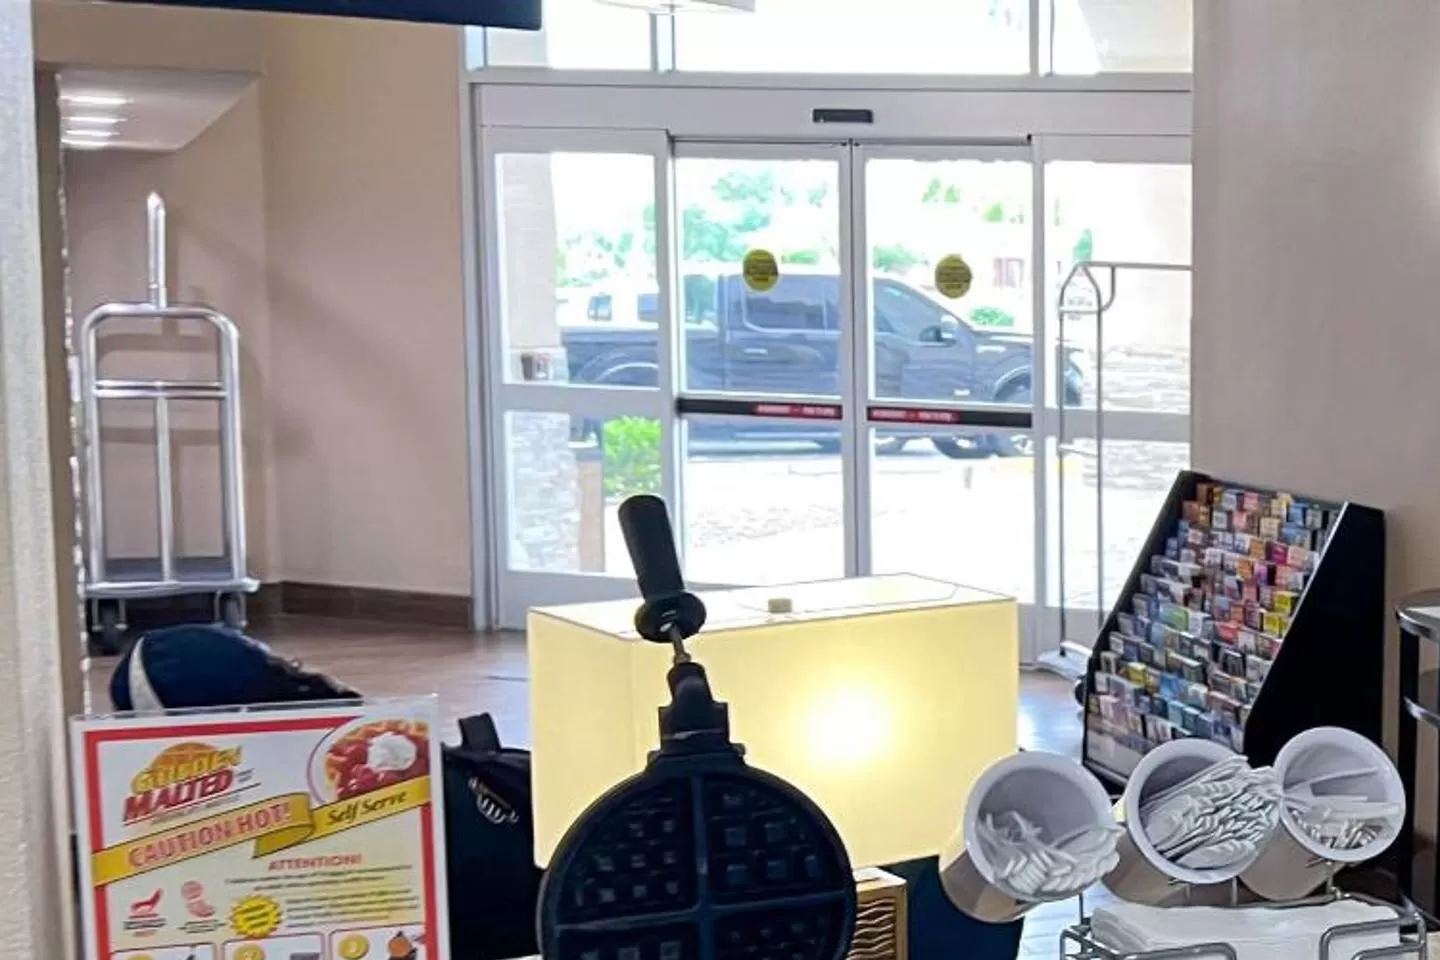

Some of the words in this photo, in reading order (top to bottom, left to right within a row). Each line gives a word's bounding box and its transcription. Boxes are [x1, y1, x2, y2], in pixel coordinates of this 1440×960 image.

[123, 768, 235, 822] MALTED
[128, 819, 231, 868] CAUTION
[234, 802, 291, 835] HOT!
